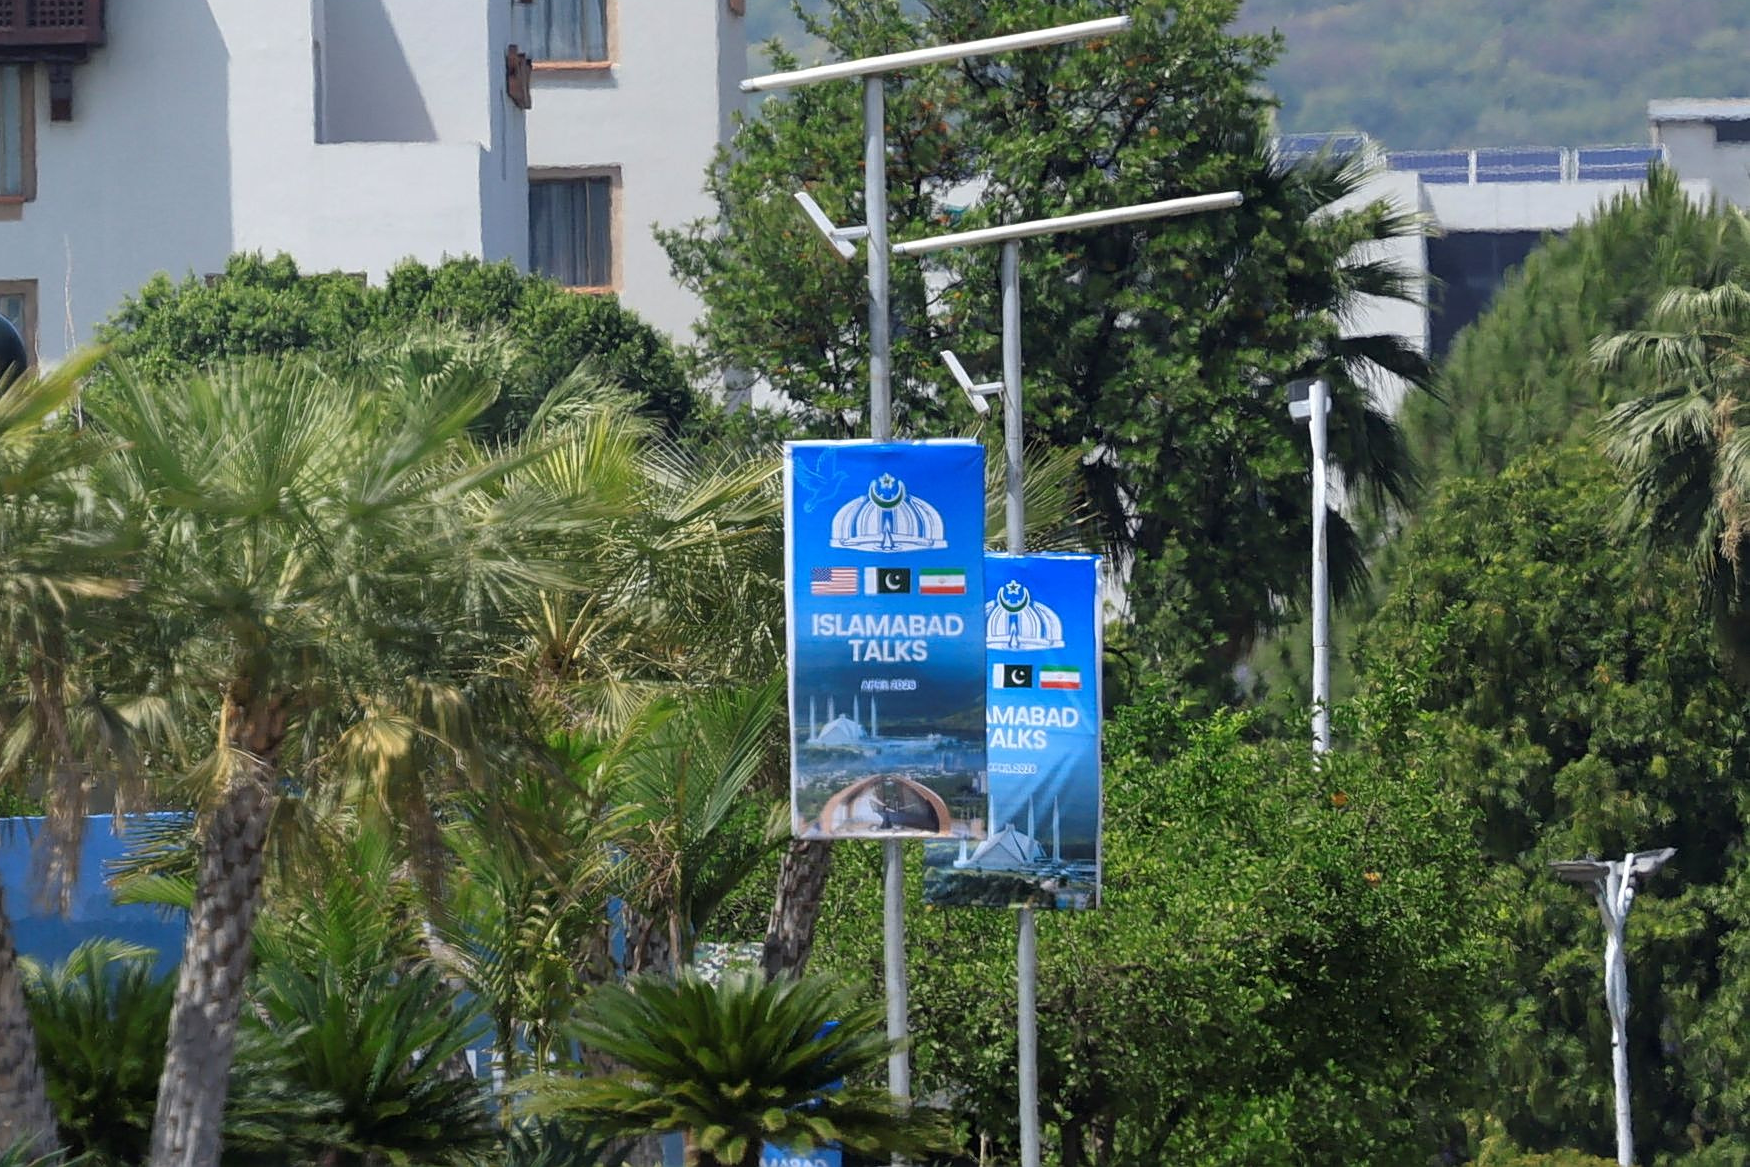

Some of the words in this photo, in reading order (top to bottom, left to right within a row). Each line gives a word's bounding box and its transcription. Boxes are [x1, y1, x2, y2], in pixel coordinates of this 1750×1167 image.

[811, 613, 965, 637] ISLAMABAD
[848, 638, 928, 662] TALKS
[986, 727, 1047, 750] ALKS
